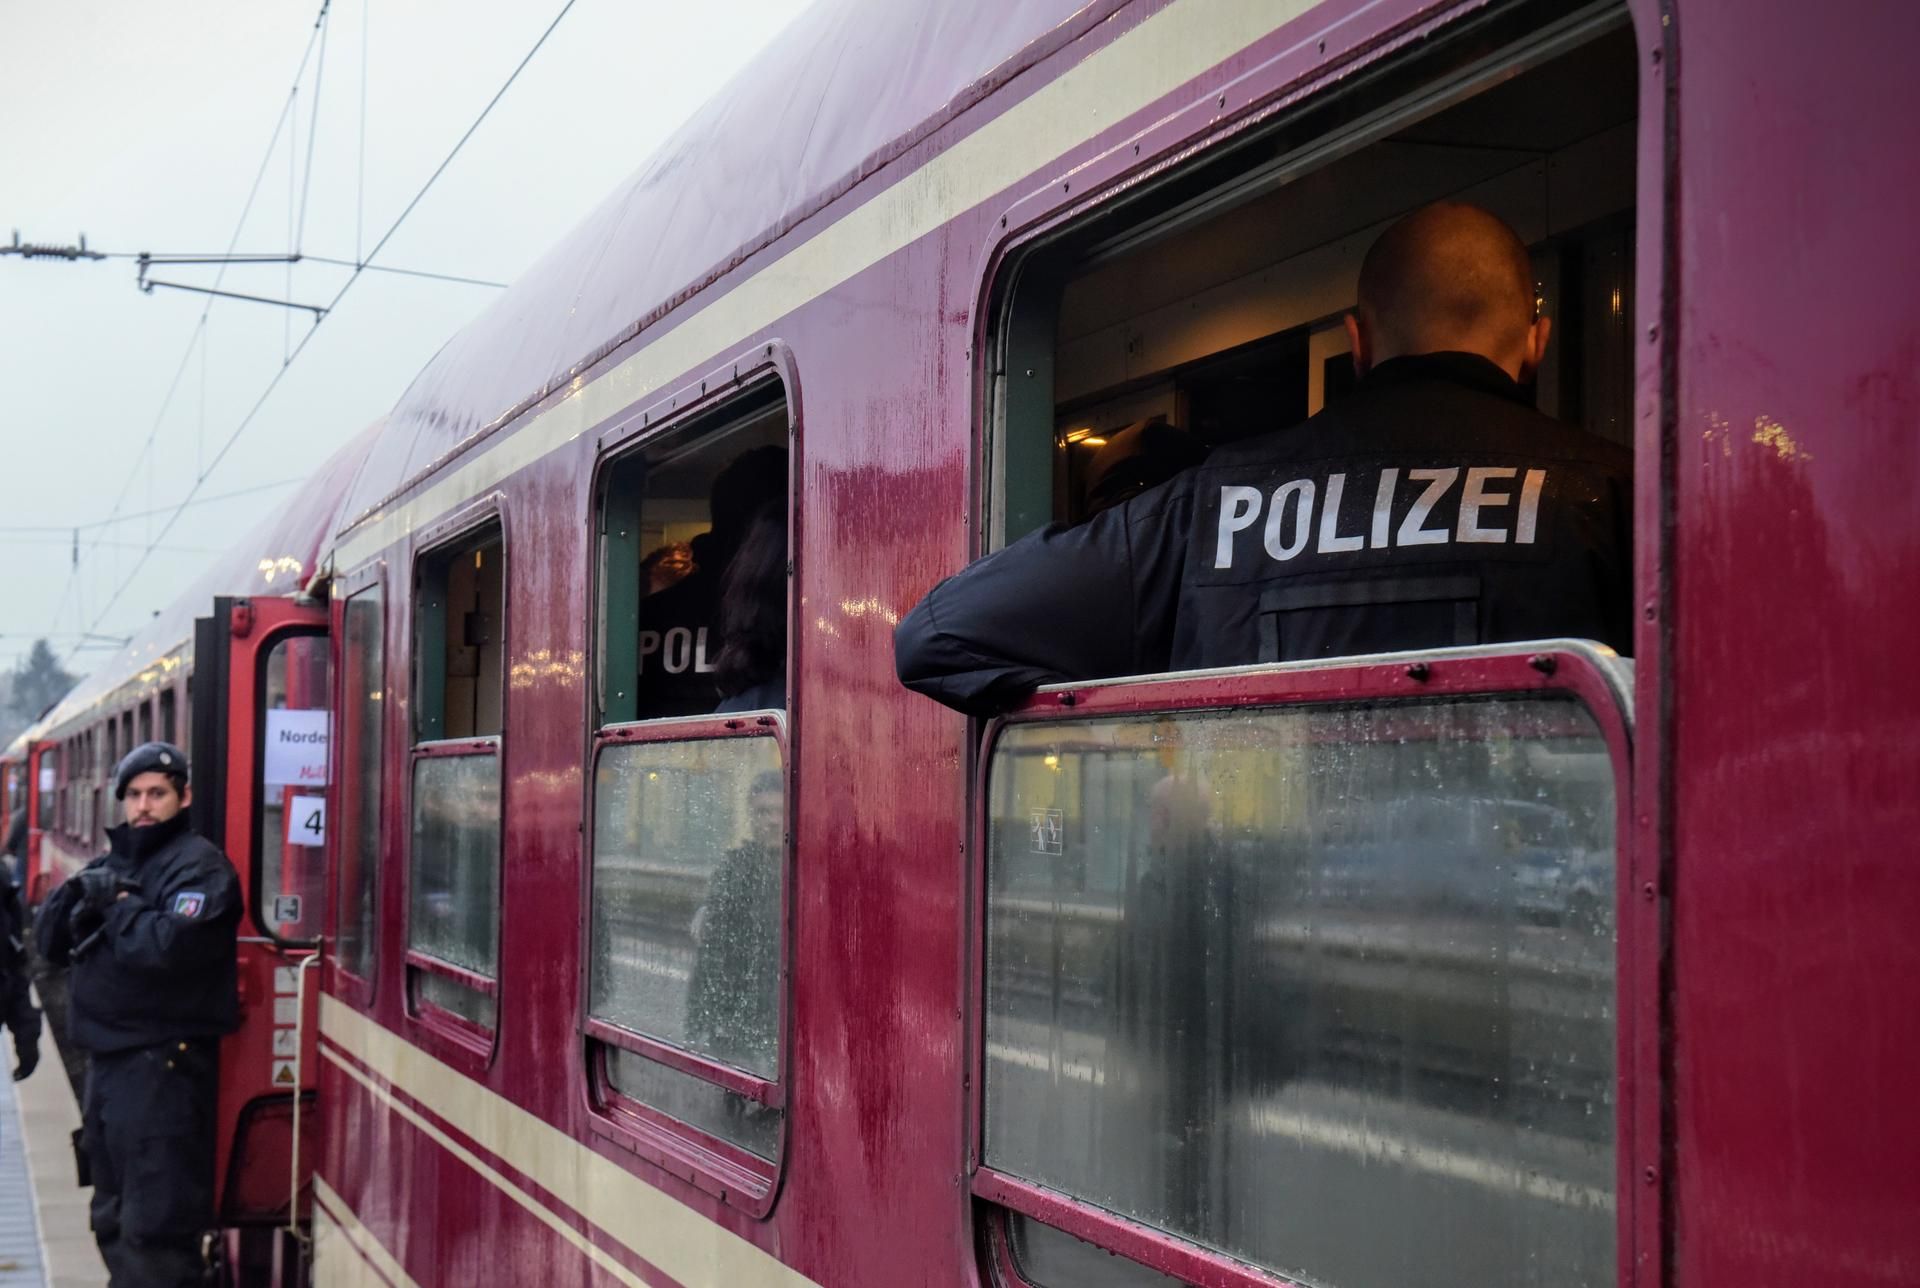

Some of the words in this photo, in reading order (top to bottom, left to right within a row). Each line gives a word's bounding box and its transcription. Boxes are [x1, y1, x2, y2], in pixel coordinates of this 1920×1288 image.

[1214, 467, 1546, 569] POLIZEI
[639, 626, 719, 676] POL
[304, 810, 324, 835] 4
